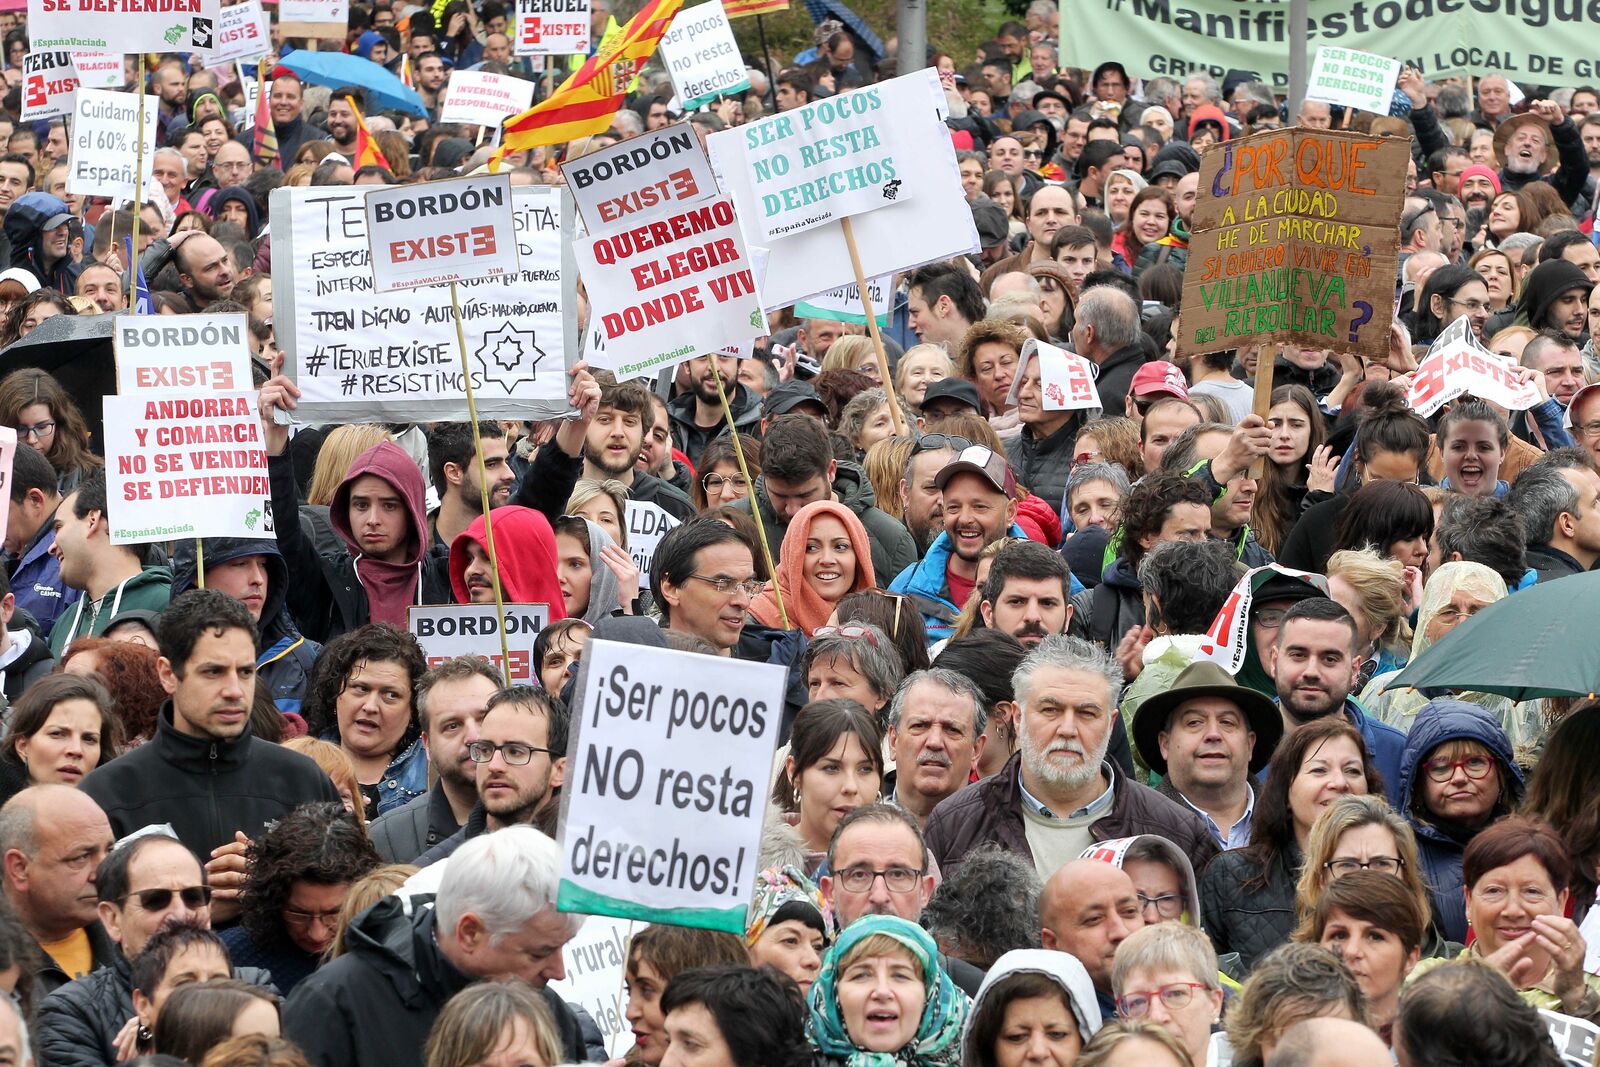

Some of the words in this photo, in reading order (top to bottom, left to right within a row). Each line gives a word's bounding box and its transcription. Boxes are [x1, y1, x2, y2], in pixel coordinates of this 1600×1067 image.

[43, 0, 71, 12] SE
[79, 0, 201, 13] DEFIENDEN
[519, 0, 587, 13] TERUEL
[686, 13, 724, 42] pocos
[24, 51, 73, 74] TERU
[672, 55, 692, 73] no
[694, 40, 733, 65] resta
[1434, 47, 1518, 71] LOCAL
[1528, 54, 1563, 75] DE
[80, 99, 151, 124] Cuidams
[745, 116, 798, 150] SER
[801, 86, 882, 131] POCOS
[78, 130, 92, 149] el
[97, 130, 127, 152] 60%
[752, 153, 790, 184] NO
[799, 124, 881, 169] RESTA
[572, 131, 694, 190] BORDÓN
[761, 156, 897, 218] DERECHOS
[304, 195, 367, 243] TE
[374, 184, 504, 223] BORDÓN
[512, 203, 560, 232] SITA:
[1219, 205, 1237, 228] A
[1244, 195, 1269, 223] LA
[1272, 188, 1339, 219] CIUDAD
[592, 199, 738, 266] QUEREMO
[768, 211, 833, 237] #EspañaVaciada
[1216, 227, 1241, 251] HE
[1248, 221, 1270, 246] DE
[630, 237, 740, 292] ELEGIR
[1200, 256, 1222, 281] SI
[1225, 243, 1285, 275] QUIERO
[1292, 244, 1339, 274] VIVIR
[1345, 252, 1372, 279] EN
[316, 274, 374, 297] INTERN
[844, 279, 884, 306] juscia.
[1199, 265, 1346, 313] VILLANUEVA
[601, 285, 704, 341] DONDE
[707, 268, 756, 304] VIV
[122, 321, 241, 348] BORDÓN
[1193, 325, 1216, 345] DEL
[1223, 301, 1338, 339] REBOLLAR
[618, 343, 696, 376] #EspañaVaciada
[144, 397, 251, 420] ANDORRA
[134, 428, 149, 447] Y
[156, 423, 259, 446] COMARCA
[118, 454, 147, 475] NO
[154, 453, 183, 473] SE
[189, 449, 268, 470] VENDEN
[123, 481, 152, 502] SE
[158, 475, 270, 499] DEFIENDEN
[113, 523, 195, 539] #EspañaVaciada
[416, 611, 541, 637] BORDÓN
[592, 664, 662, 729] ¡Ser
[666, 687, 768, 739] pocos
[581, 743, 645, 801] NO
[655, 765, 754, 818] resta
[570, 824, 746, 897] derechos!
[571, 925, 632, 976] rural
